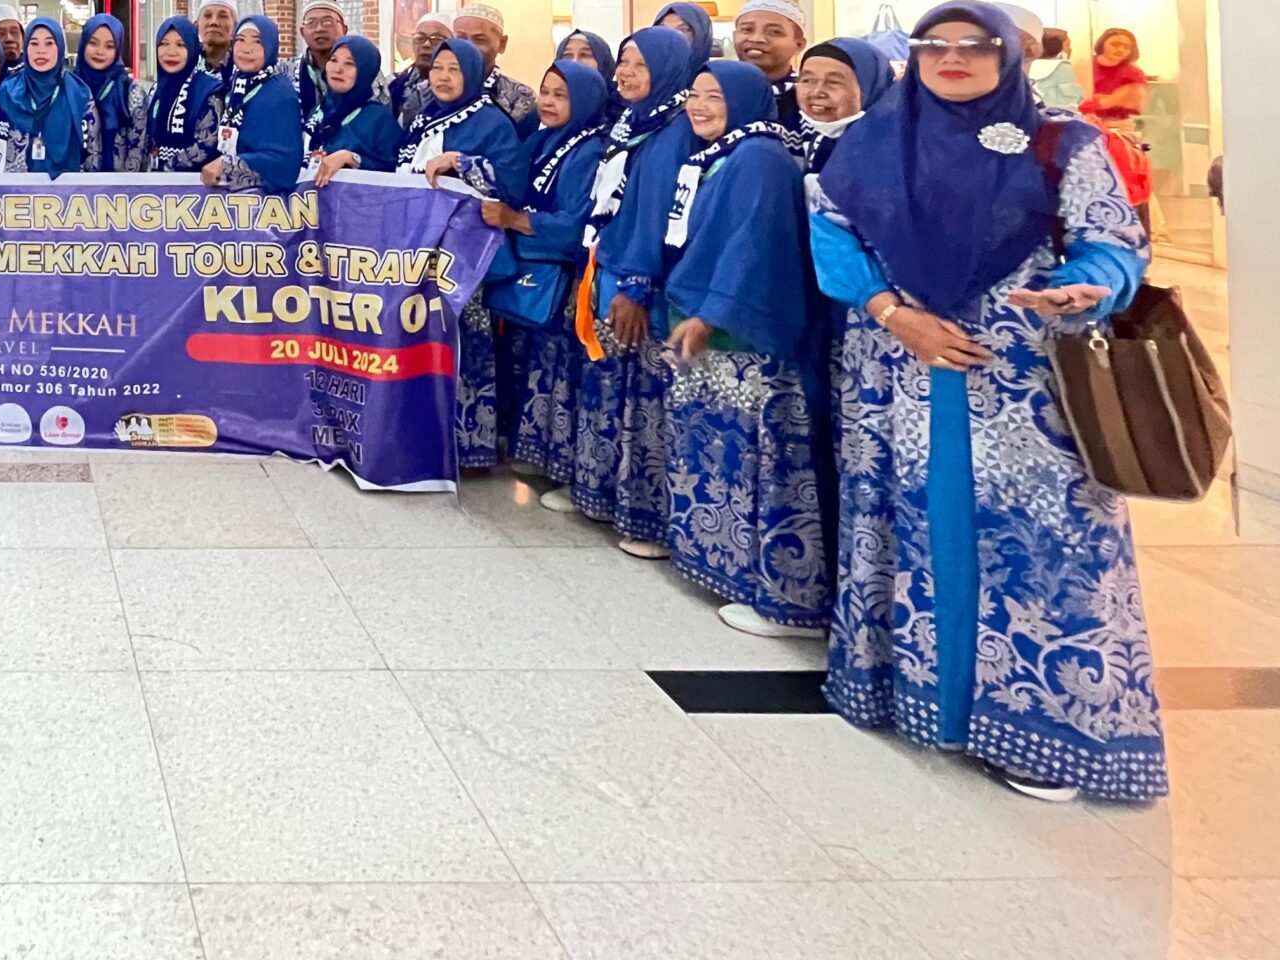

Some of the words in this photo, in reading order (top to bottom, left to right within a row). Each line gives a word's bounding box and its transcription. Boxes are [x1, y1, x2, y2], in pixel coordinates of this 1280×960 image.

[166, 242, 288, 277] TOUR
[295, 240, 323, 278] &
[8, 307, 137, 337] MEKKAH
[203, 284, 383, 335] KLOTER
[11, 365, 34, 377] NO
[40, 365, 108, 379] 536/2020
[270, 339, 300, 359] 20
[307, 340, 348, 366] JULI
[352, 349, 399, 375] 2024
[36, 382, 63, 395] 306
[69, 385, 117, 397] Tahun
[123, 383, 160, 395] 2022
[304, 369, 327, 392] 12
[327, 375, 366, 406] HARI
